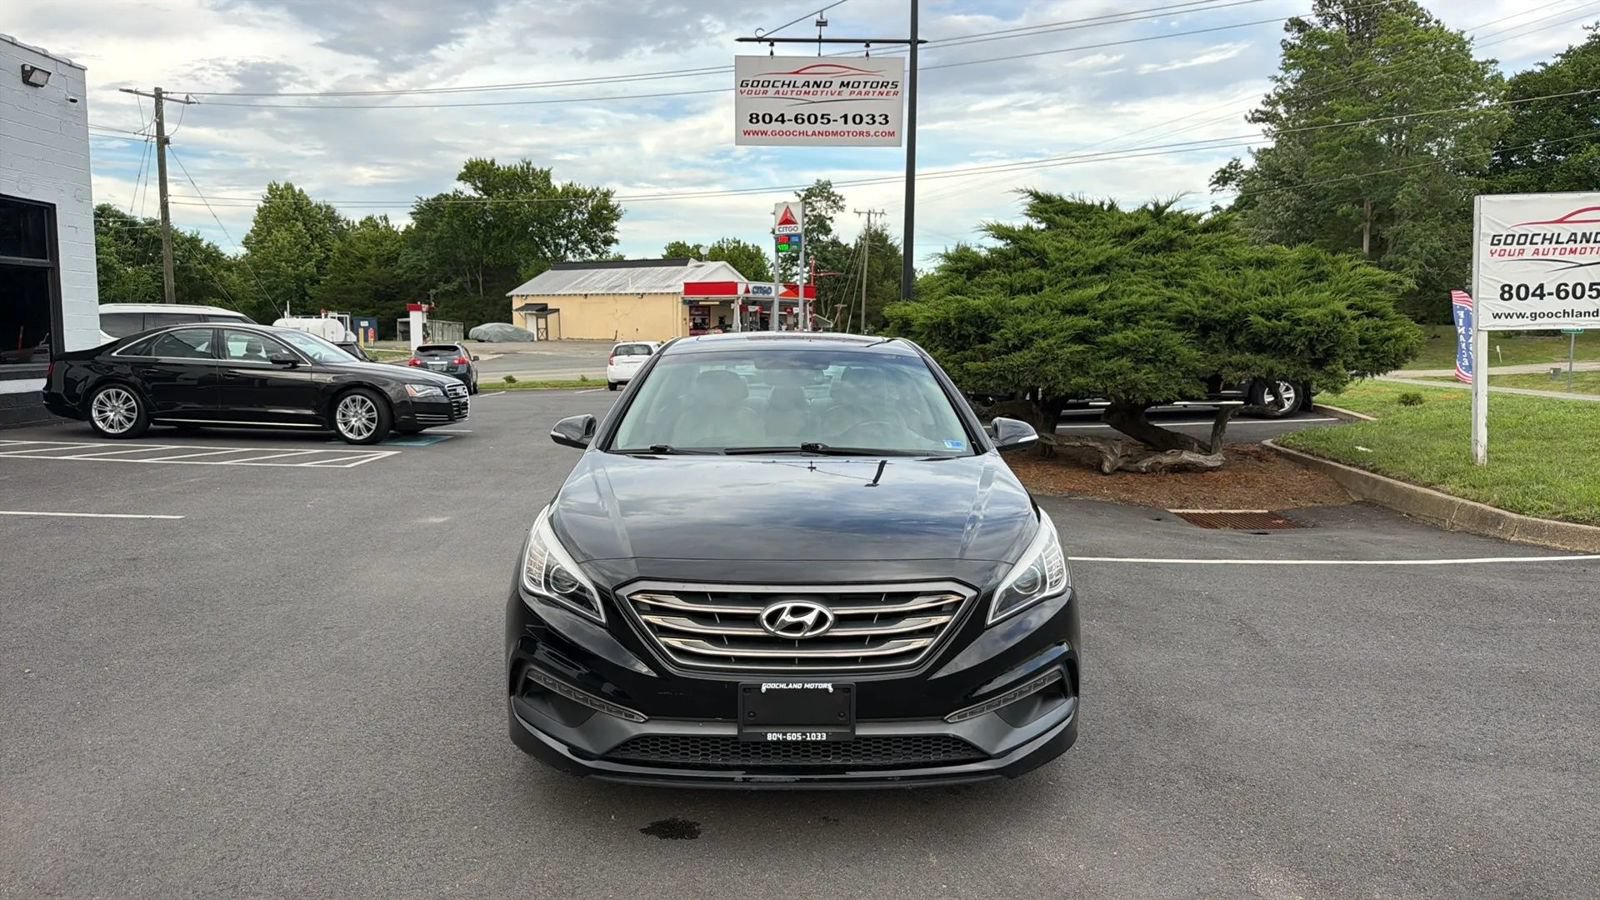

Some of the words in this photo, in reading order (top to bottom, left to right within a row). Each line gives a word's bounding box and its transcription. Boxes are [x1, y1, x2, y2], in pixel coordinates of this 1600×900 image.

[739, 79, 833, 89] GOOCHLAND
[839, 80, 899, 90] MOTORS
[774, 89, 844, 97] AUTOMOTIVE
[748, 112, 890, 125] 804-605-1033
[742, 129, 896, 138] WWW.GOOCHLANDMOTORS.COM
[1489, 248, 1526, 257] YOUR
[752, 286, 773, 295] CITGO
[1499, 282, 1600, 301] 804-605
[1492, 308, 1600, 321] www.goochland
[766, 732, 827, 741] 804-605-1033
